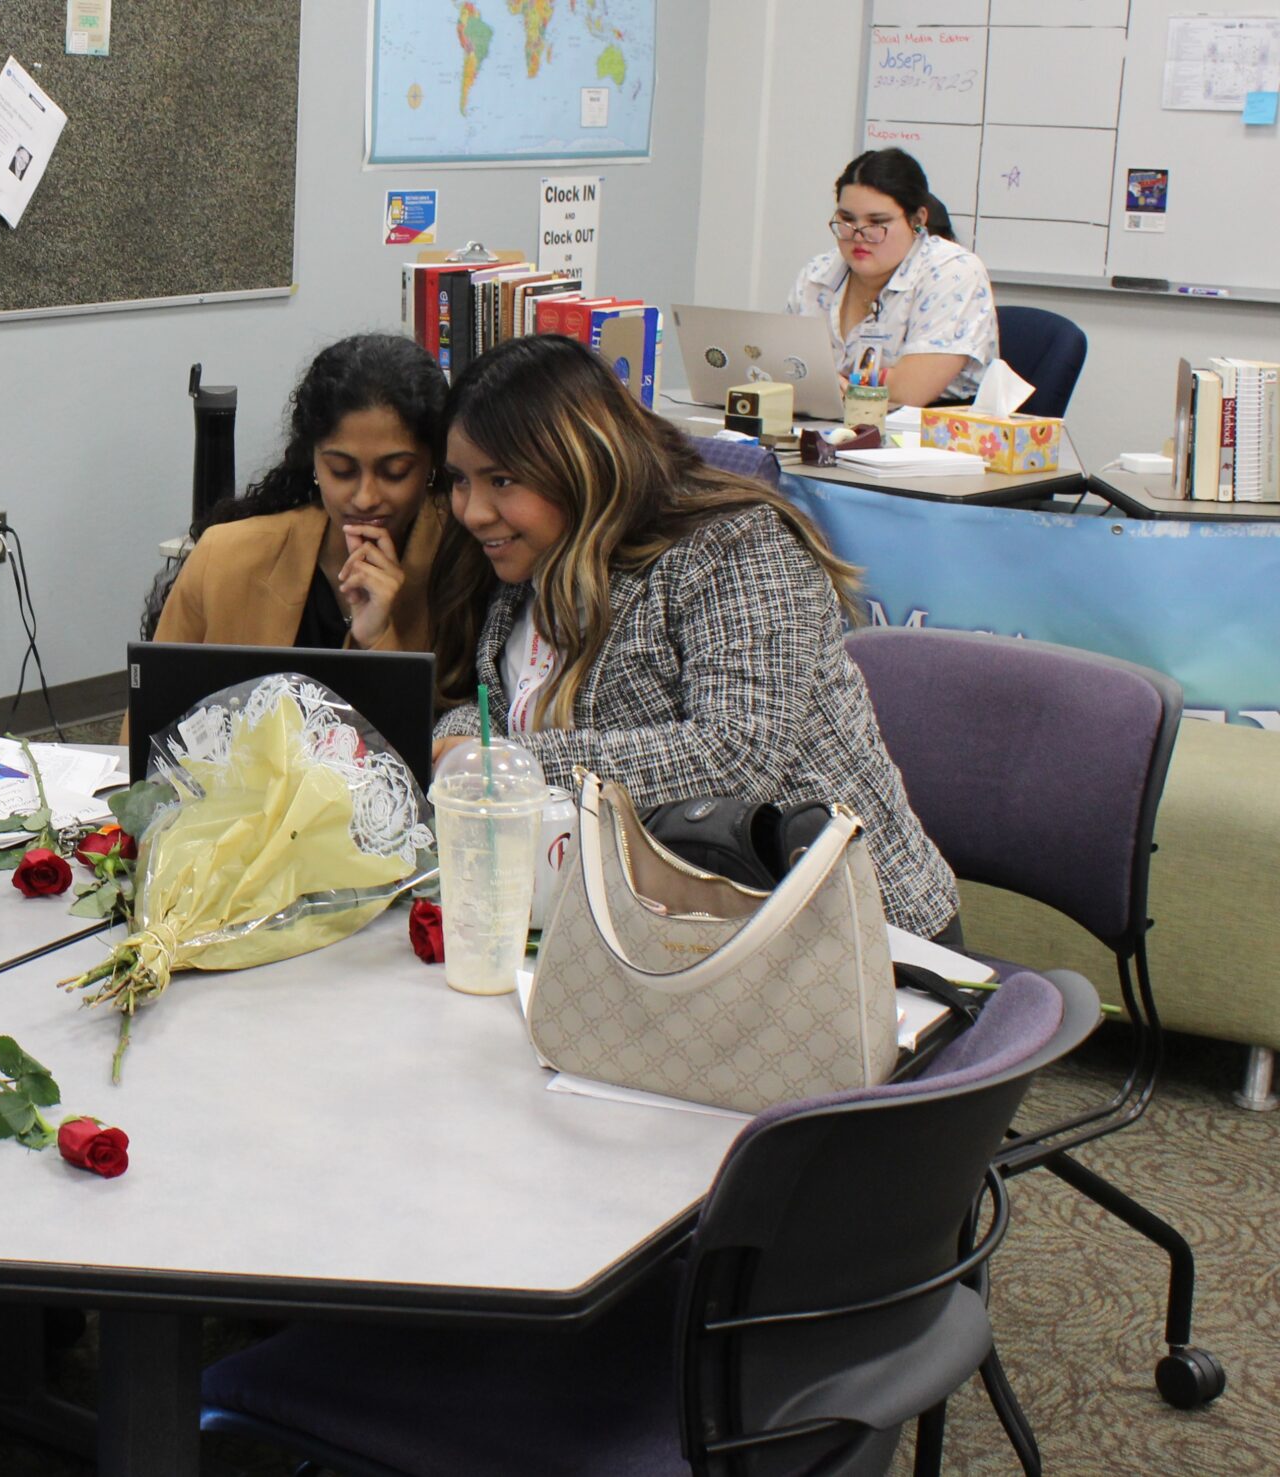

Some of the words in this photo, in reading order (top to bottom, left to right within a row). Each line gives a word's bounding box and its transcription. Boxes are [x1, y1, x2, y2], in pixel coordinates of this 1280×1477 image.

[873, 29, 900, 44] Social
[905, 33, 933, 43] Media
[939, 32, 970, 43] Editor
[868, 123, 921, 141] Reporters
[545, 185, 580, 203] Clock
[583, 185, 596, 201] IN
[565, 212, 576, 220] AND
[544, 230, 573, 245] Clock
[575, 229, 595, 243] OUT
[565, 254, 572, 262] OR
[1223, 400, 1234, 446] Stylebook
